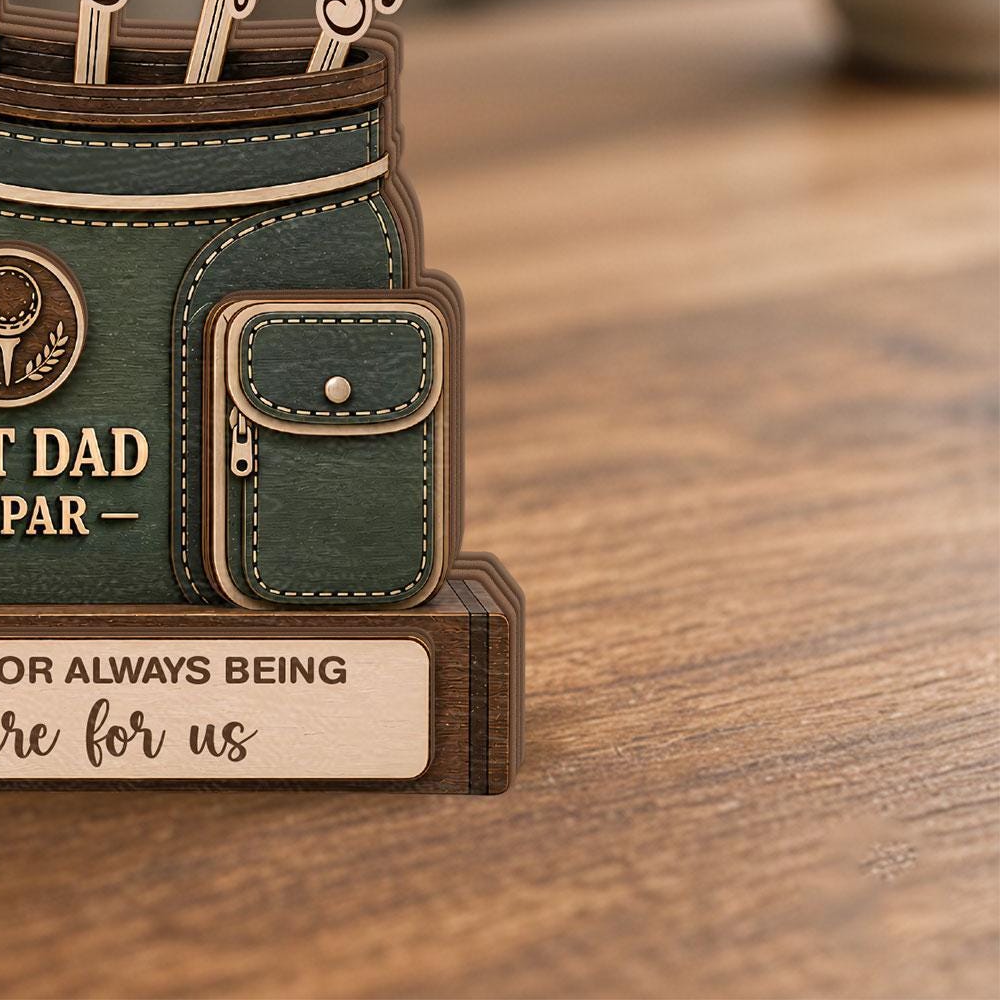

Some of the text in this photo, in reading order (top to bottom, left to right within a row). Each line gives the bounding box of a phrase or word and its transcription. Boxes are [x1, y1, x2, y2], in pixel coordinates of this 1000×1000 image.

[33, 427, 150, 478] DAD
[0, 495, 90, 536] PAR
[64, 656, 211, 685] ALWAYS
[225, 656, 347, 685] BEING
[85, 697, 167, 768] for
[189, 721, 259, 763] us
